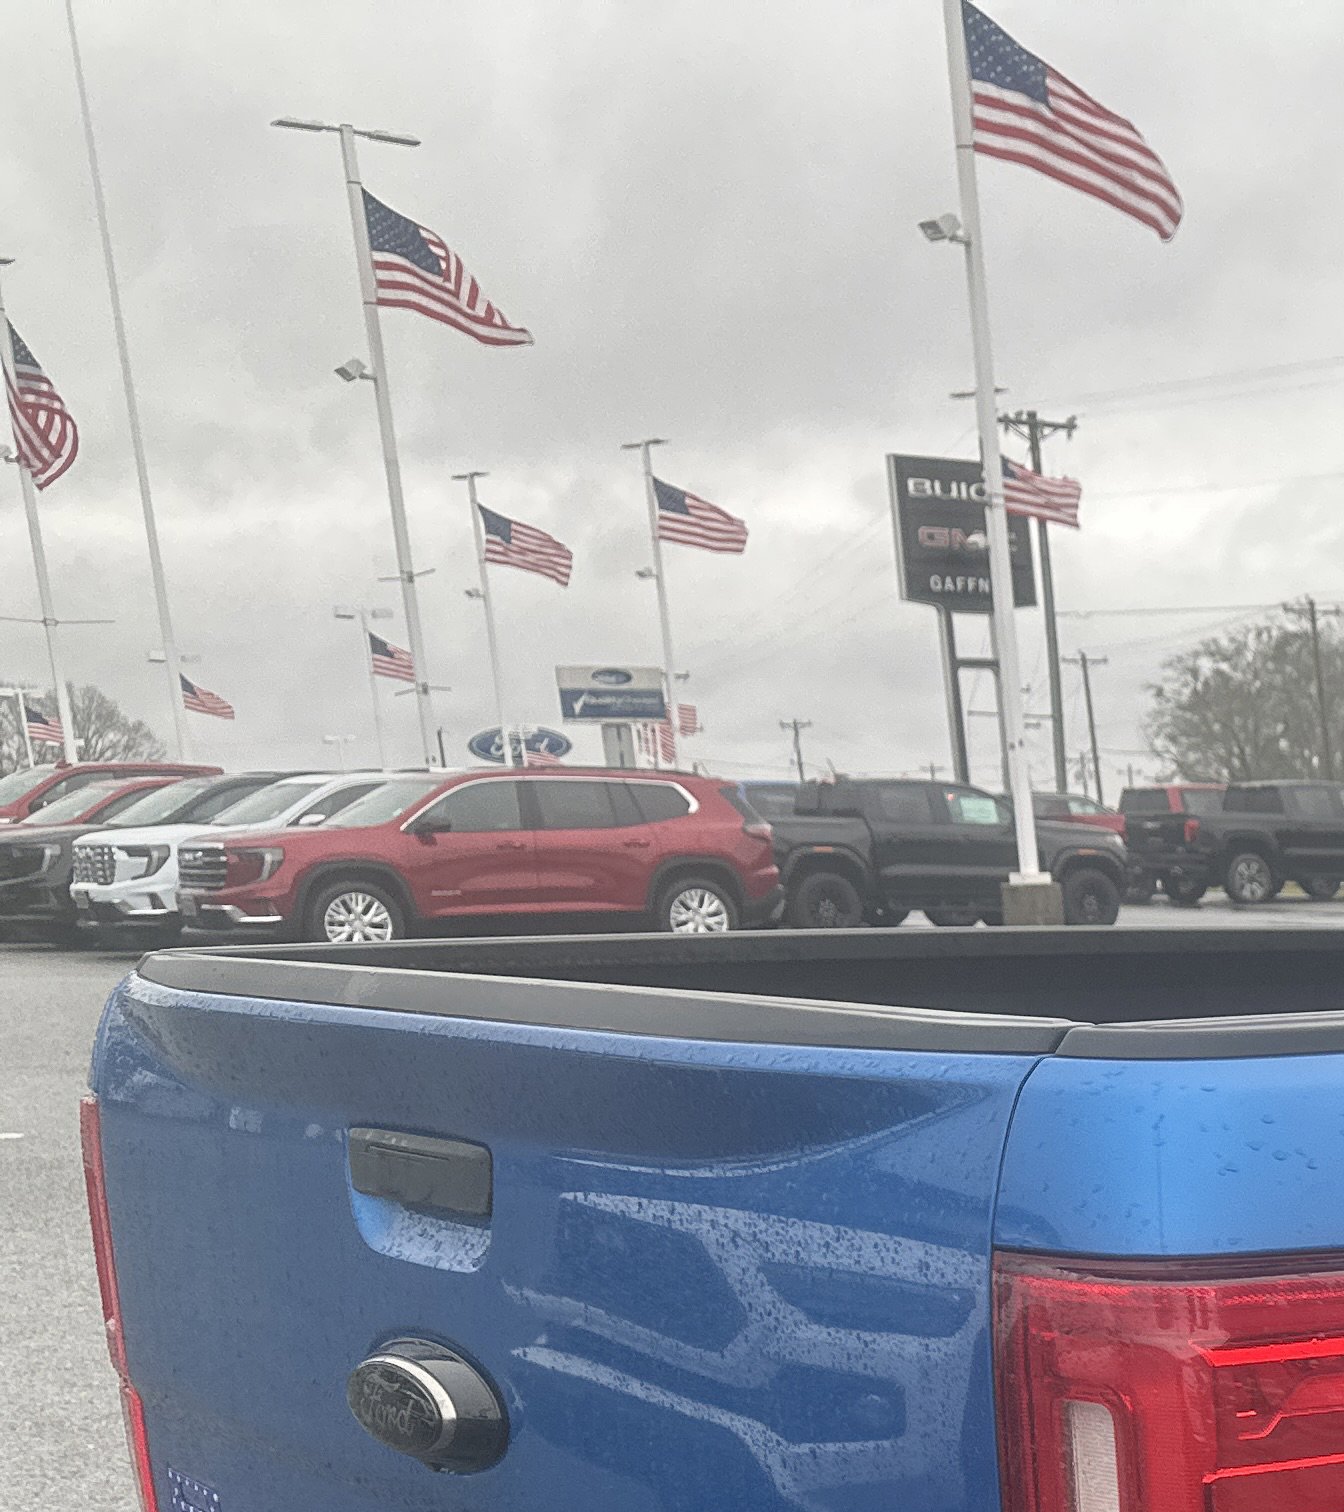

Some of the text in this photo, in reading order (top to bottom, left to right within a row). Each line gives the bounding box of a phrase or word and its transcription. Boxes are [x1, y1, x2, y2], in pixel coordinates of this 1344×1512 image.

[907, 477, 988, 502] BUIC
[929, 574, 991, 593] GAFFN
[359, 1371, 417, 1437] Ford
